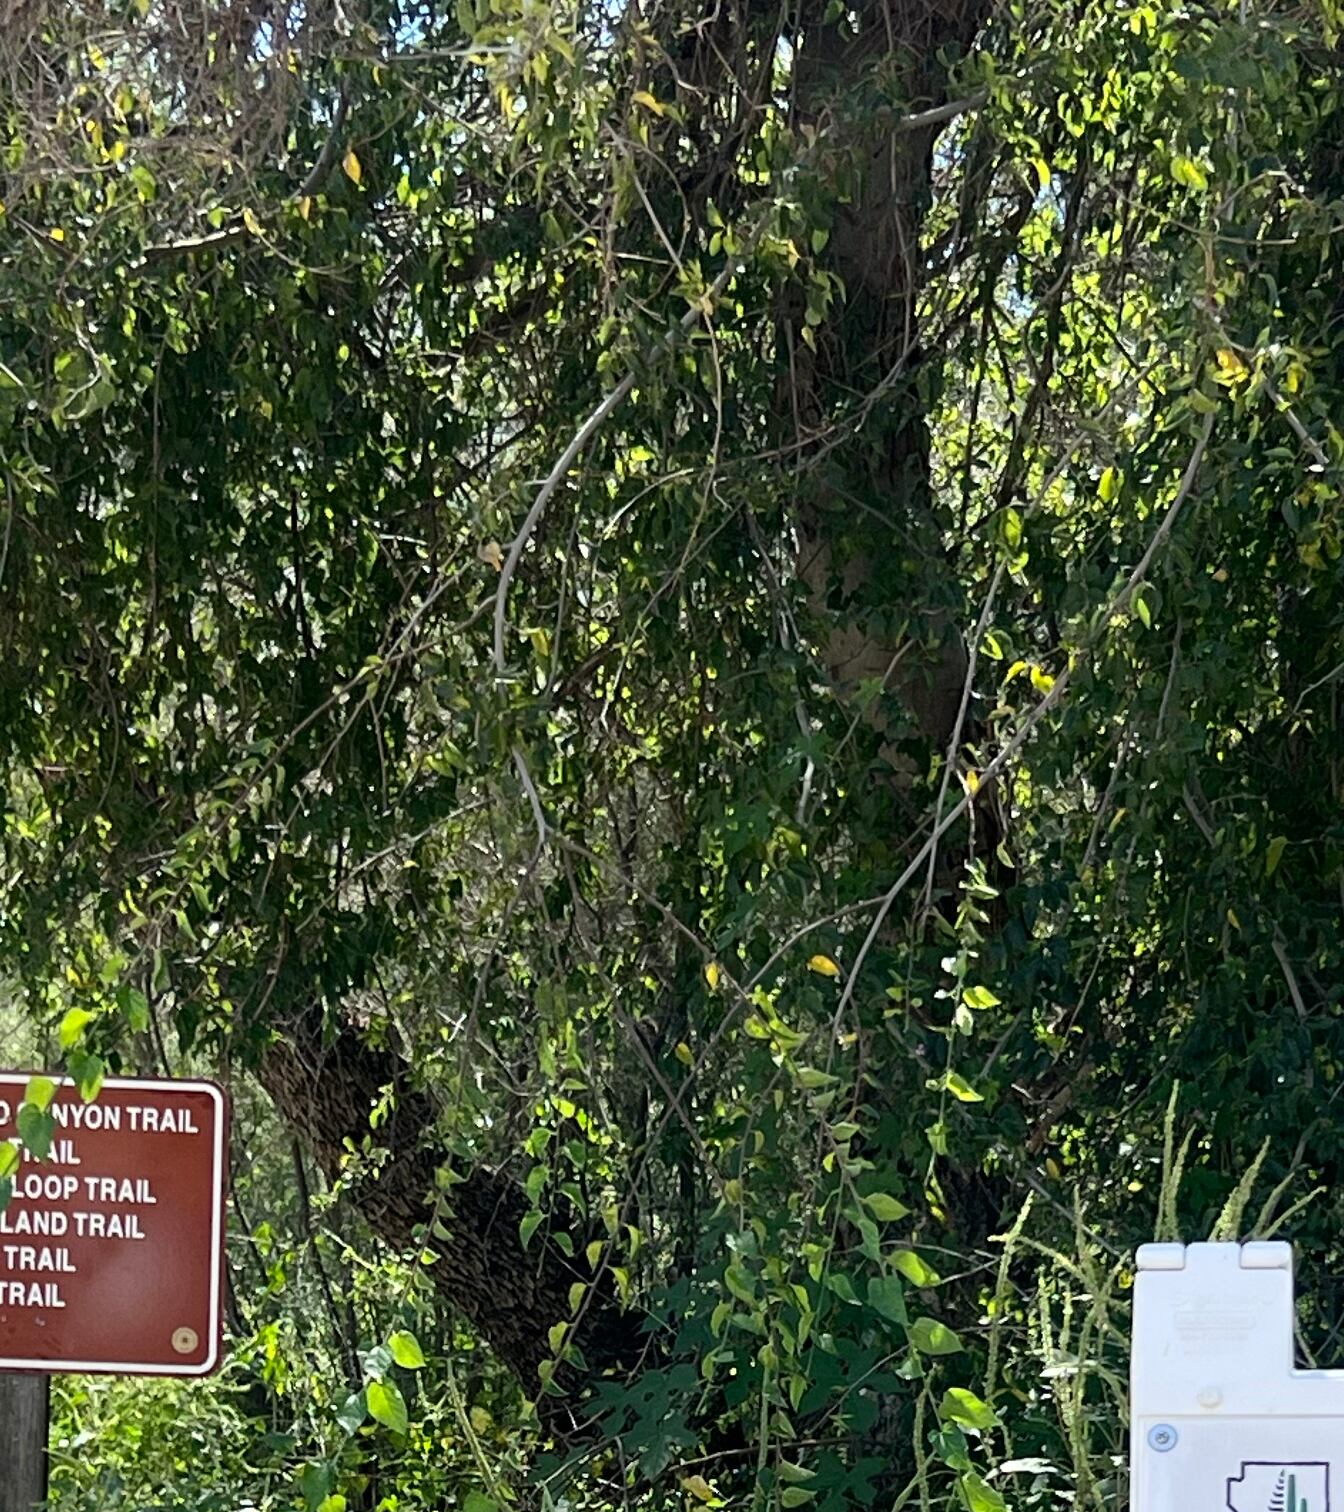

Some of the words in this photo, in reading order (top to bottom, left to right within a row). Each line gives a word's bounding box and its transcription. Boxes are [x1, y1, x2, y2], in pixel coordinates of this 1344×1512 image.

[17, 1102, 120, 1131] NYON
[126, 1107, 198, 1133] TRAIL
[8, 1137, 81, 1165] TAIL
[11, 1173, 79, 1200] LOOP
[84, 1177, 156, 1203] TRAIL
[73, 1213, 145, 1238] TRAIL
[4, 1246, 76, 1272] TRAIL
